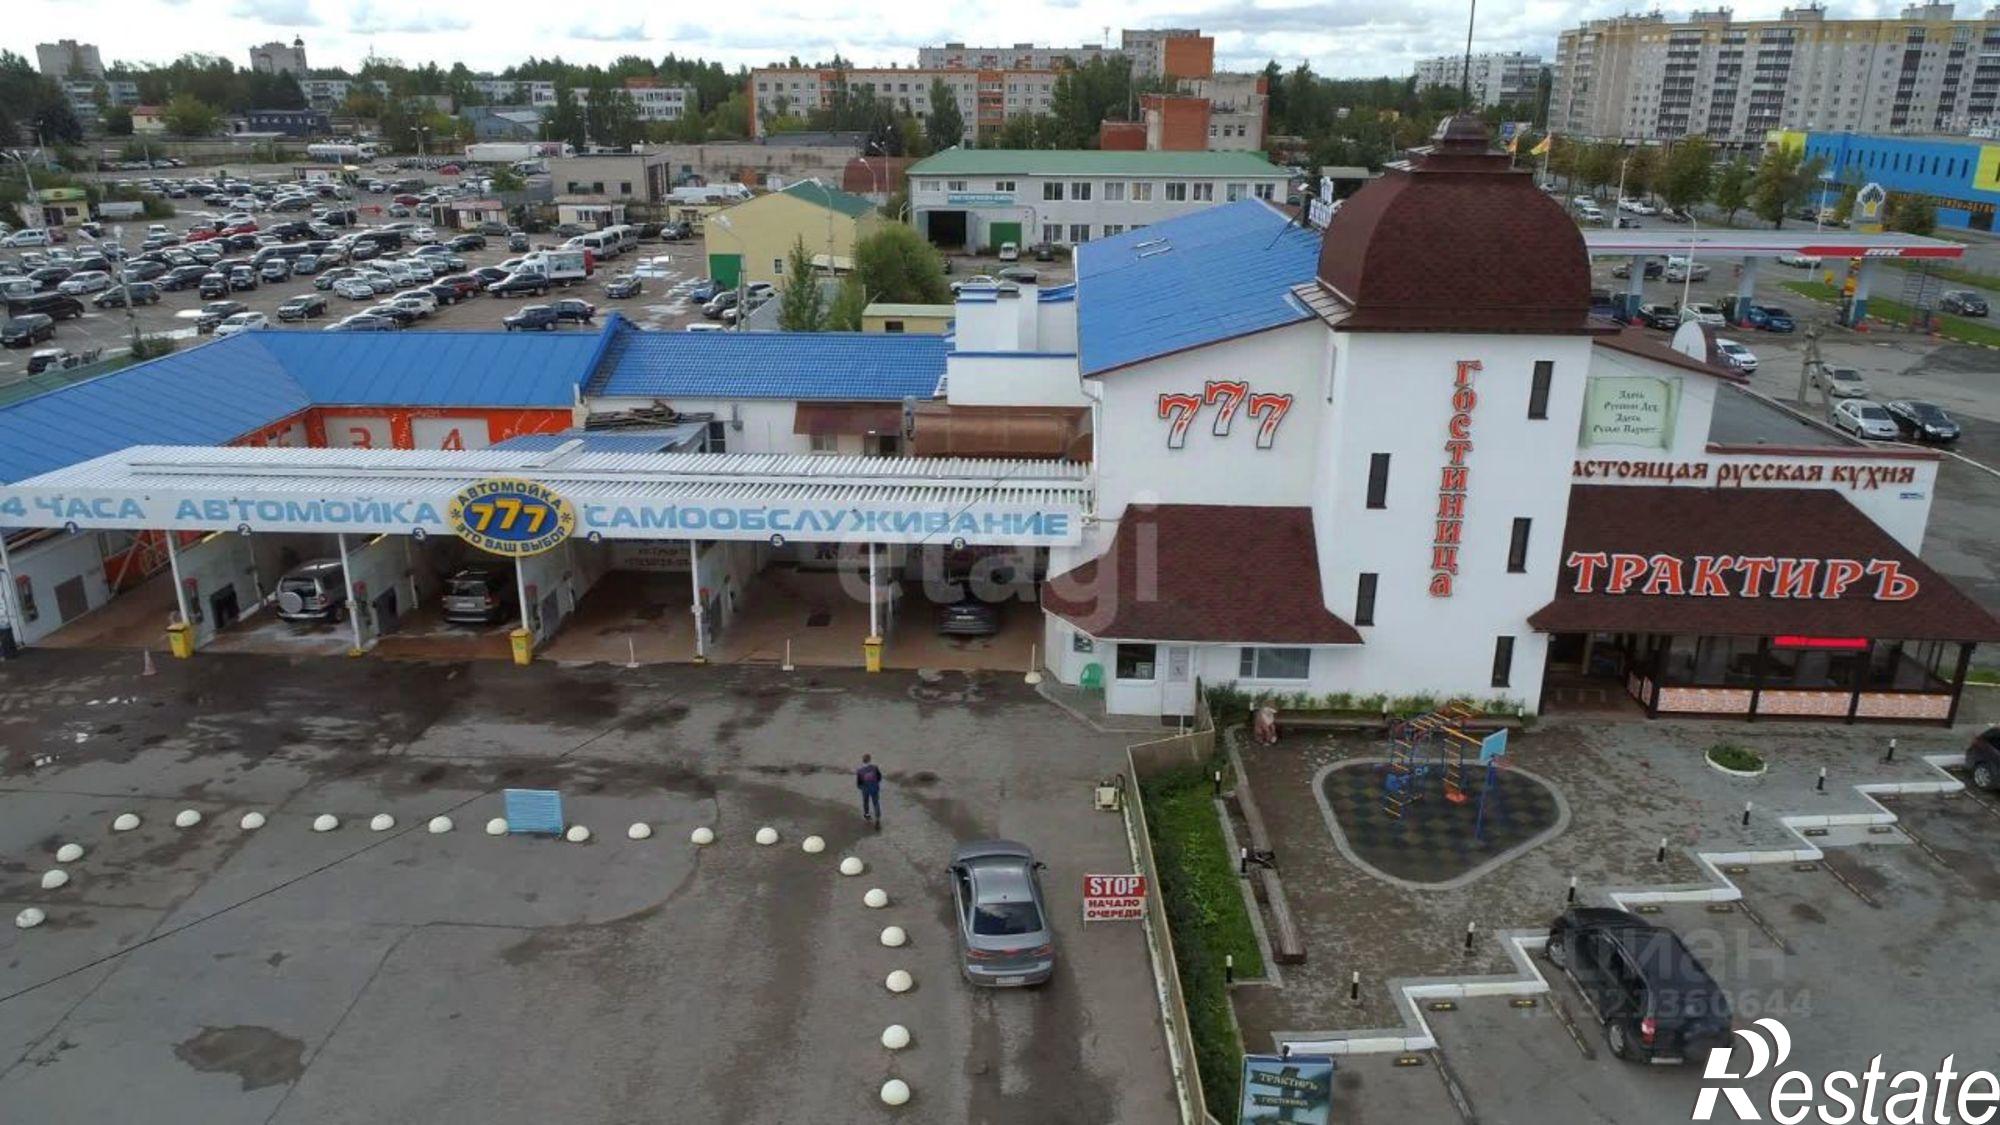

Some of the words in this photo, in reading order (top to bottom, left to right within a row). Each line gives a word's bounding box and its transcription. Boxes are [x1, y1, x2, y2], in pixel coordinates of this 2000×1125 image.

[1158, 378, 1293, 449] 777
[1717, 462, 1823, 488] русская
[1831, 465, 1916, 489] кухня
[457, 481, 562, 510] АВТОМОЙКА
[33, 497, 146, 519] ЧАСА
[175, 496, 442, 524] АВТОМОЙКА
[471, 497, 548, 533] 777
[584, 505, 1068, 536] САМООБСЛУЖИВАНИЕ
[484, 538, 517, 552] ВАШ
[520, 525, 566, 552] ВЫБОР
[1567, 552, 1919, 601] ТРАКТИРЪ
[1090, 877, 1140, 895] STOP
[1088, 899, 1140, 908] НАЧАЛО
[1088, 910, 1142, 918] ОЧЕРЕДИ
